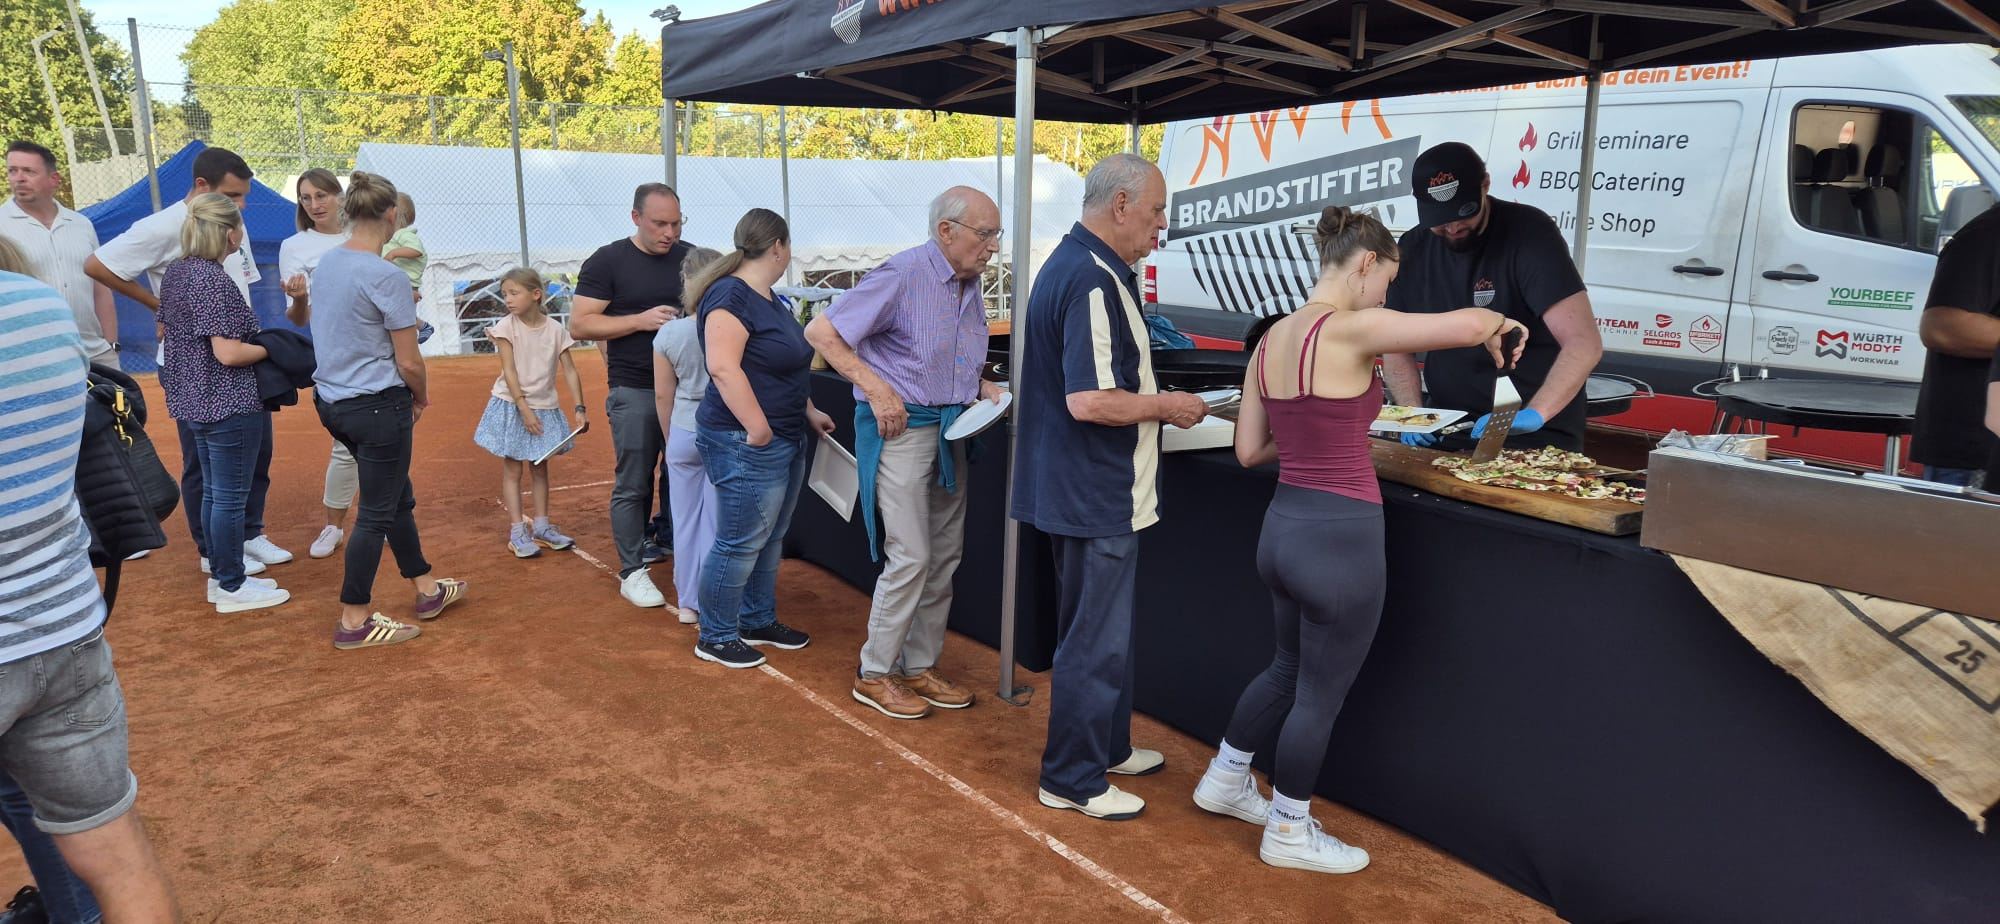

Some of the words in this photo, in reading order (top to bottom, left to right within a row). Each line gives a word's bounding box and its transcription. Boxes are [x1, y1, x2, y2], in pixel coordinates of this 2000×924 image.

[1674, 60, 1753, 82] Event!
[1547, 130, 1690, 150] Grileminare
[1178, 157, 1403, 229] BRANDSTIFTER
[1539, 171, 1580, 192] BBQ
[1591, 171, 1685, 197] Catering
[1600, 212, 1656, 238] Shop
[1830, 287, 1916, 302] YOURBEEF
[1643, 329, 1682, 339] SELGROS
[1852, 342, 1902, 353] MODYF
[1849, 356, 1899, 366] WORKWEAR
[1944, 640, 1986, 673] 25
